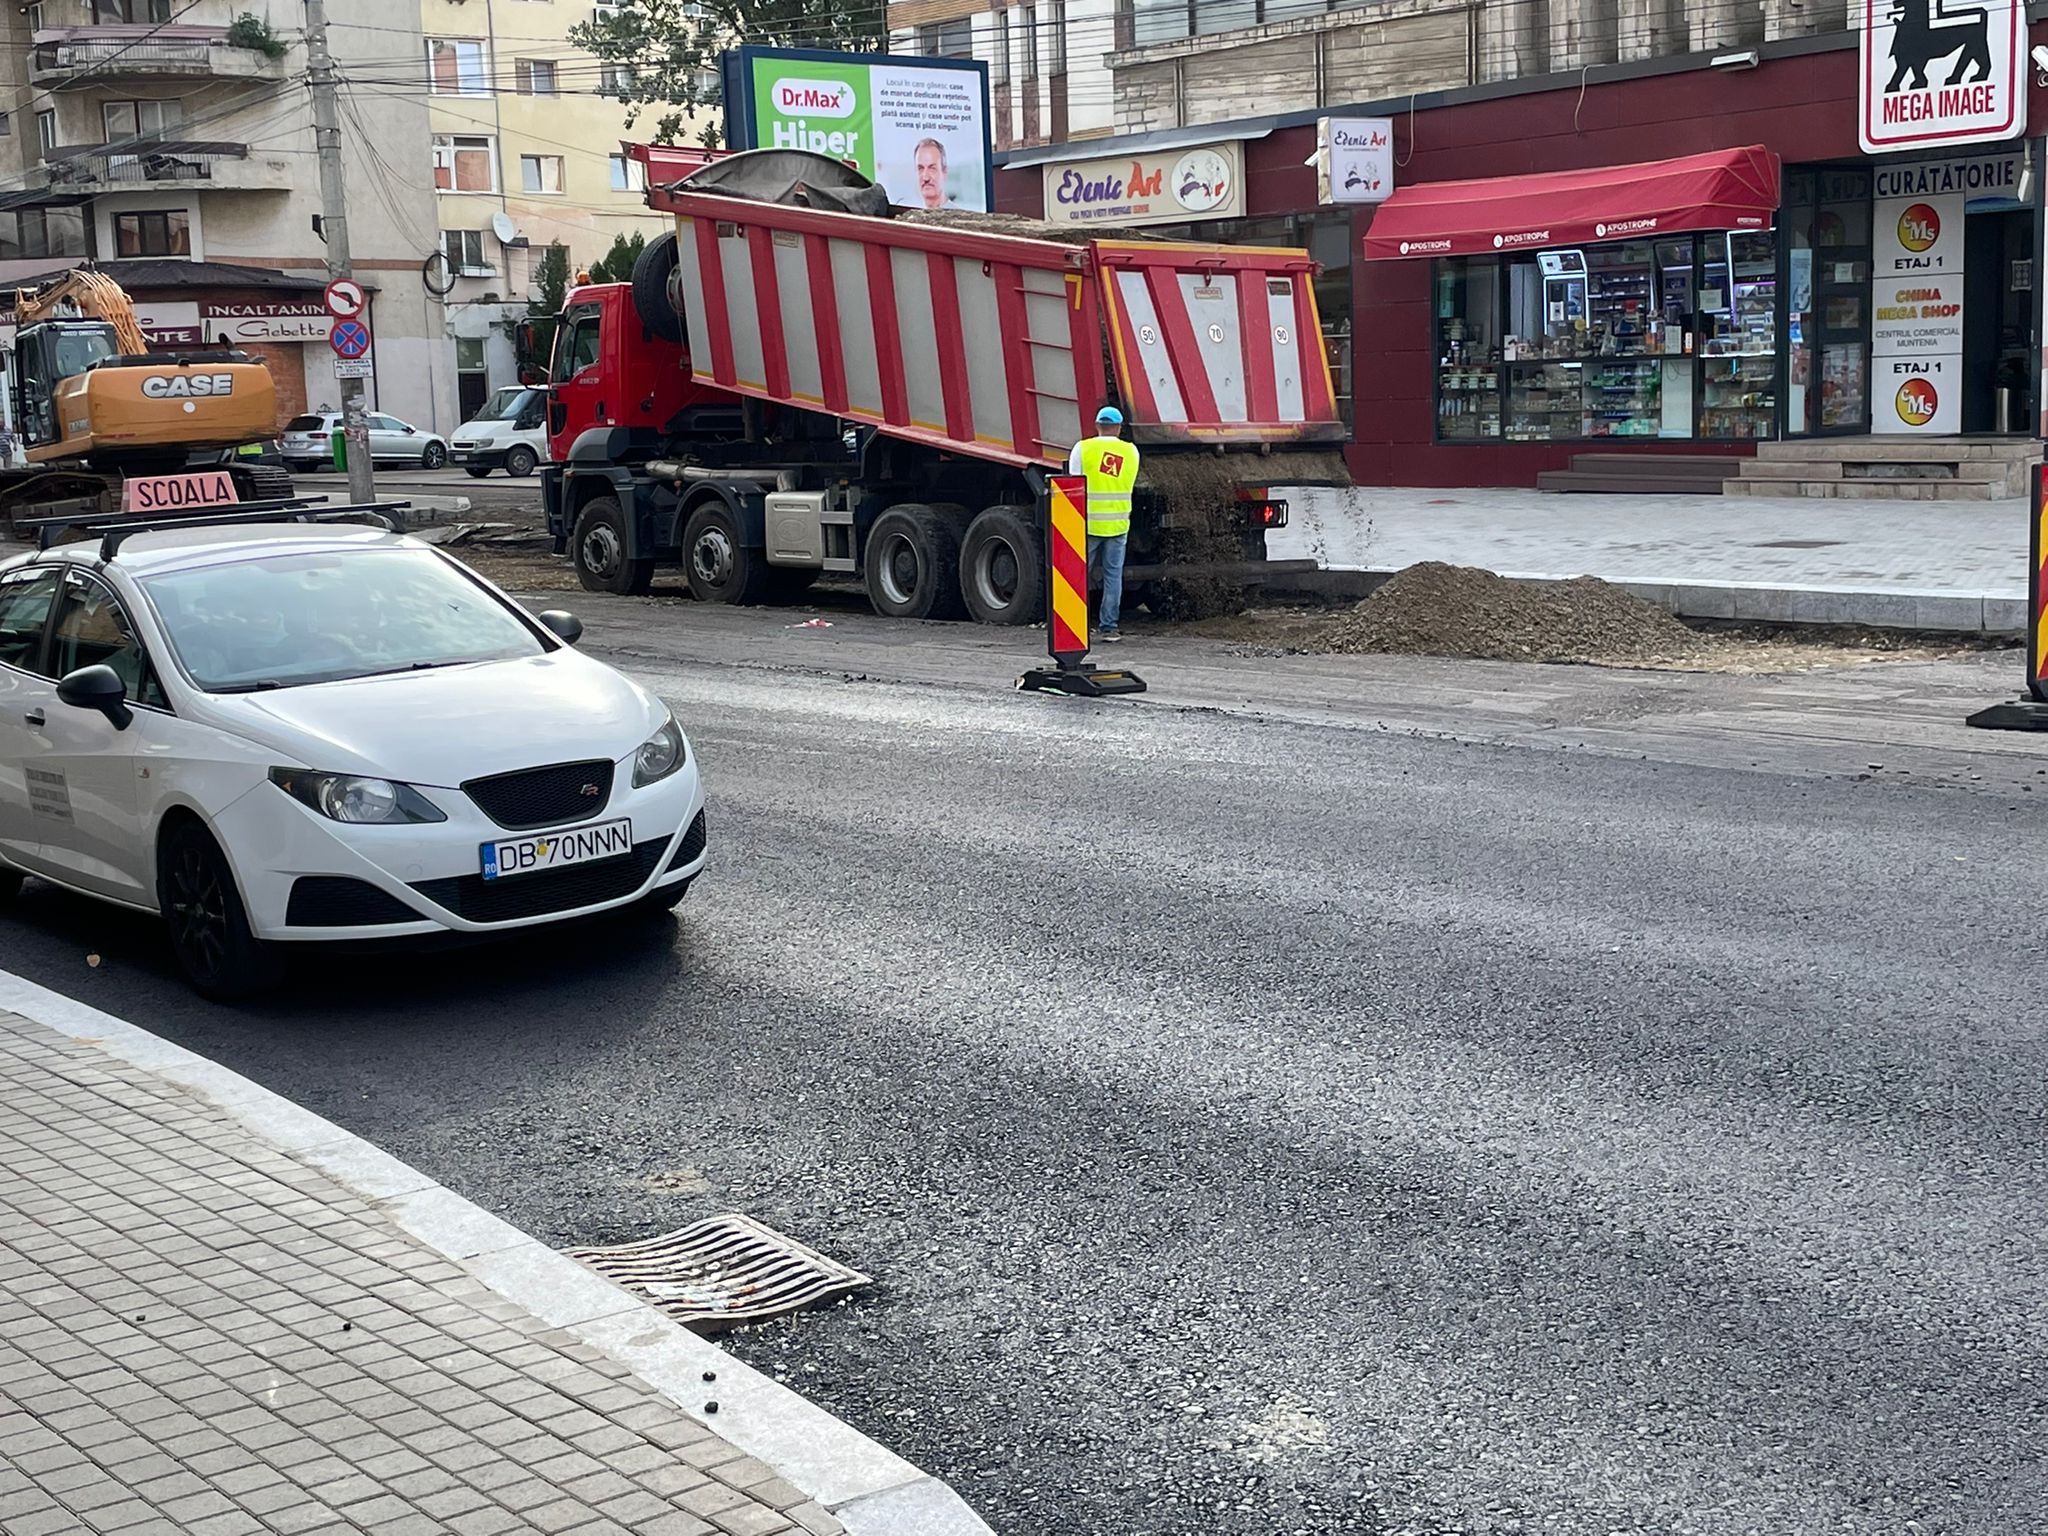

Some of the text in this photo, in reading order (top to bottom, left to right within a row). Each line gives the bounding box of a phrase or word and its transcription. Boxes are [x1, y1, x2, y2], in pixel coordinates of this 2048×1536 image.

[782, 88, 840, 108] Dr.Max
[890, 90, 912, 98] marcat
[914, 91, 941, 99] dedicate
[906, 101, 928, 109] marcat
[938, 103, 962, 111] serviciu
[964, 104, 971, 112] de
[1883, 85, 1996, 124] MEGA IMAGE
[899, 111, 920, 119] asistat
[961, 114, 972, 122] pot
[773, 120, 858, 154] Hiper
[1334, 130, 1387, 146] Edenic Art
[1056, 161, 1163, 204] Edenic Art
[1894, 256, 1944, 270] ETAJ 1
[1895, 288, 1941, 303] CHINA
[1876, 304, 1961, 321] MEGA SHOP
[236, 320, 326, 338] Gebetto
[1142, 330, 1154, 341] 50
[1210, 328, 1222, 339] 70
[1276, 330, 1287, 341] 90
[1875, 327, 1960, 339] CENTRUL COMERCIAL
[1897, 339, 1939, 348] MUNTENIA
[1893, 362, 1942, 374] ETAJ 1
[142, 373, 233, 398] CASE
[137, 476, 231, 508] SCOALA
[500, 824, 628, 872] DB 70NNN
[484, 863, 497, 875] RO
